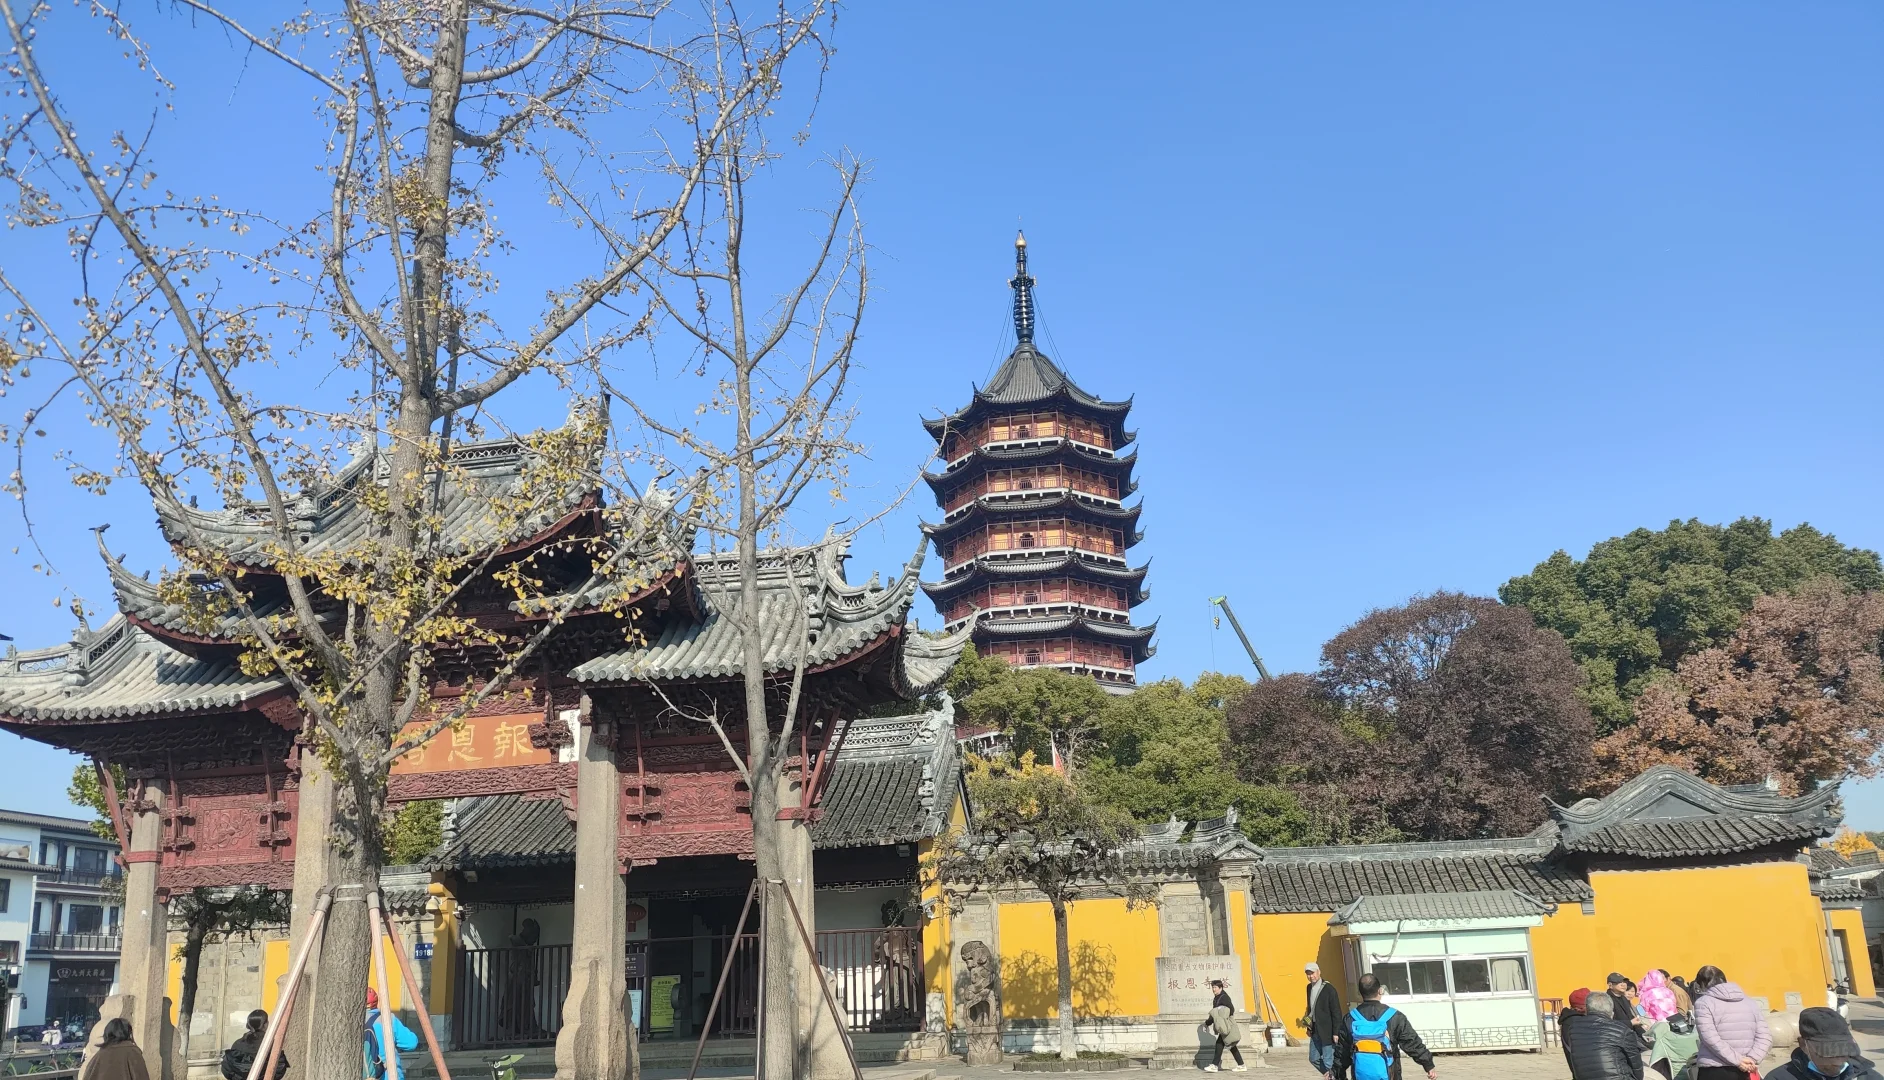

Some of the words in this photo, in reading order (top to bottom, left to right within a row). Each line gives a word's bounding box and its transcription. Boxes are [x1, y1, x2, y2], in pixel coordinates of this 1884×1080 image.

[1164, 962, 1233, 971] 全国重点文物保护单位
